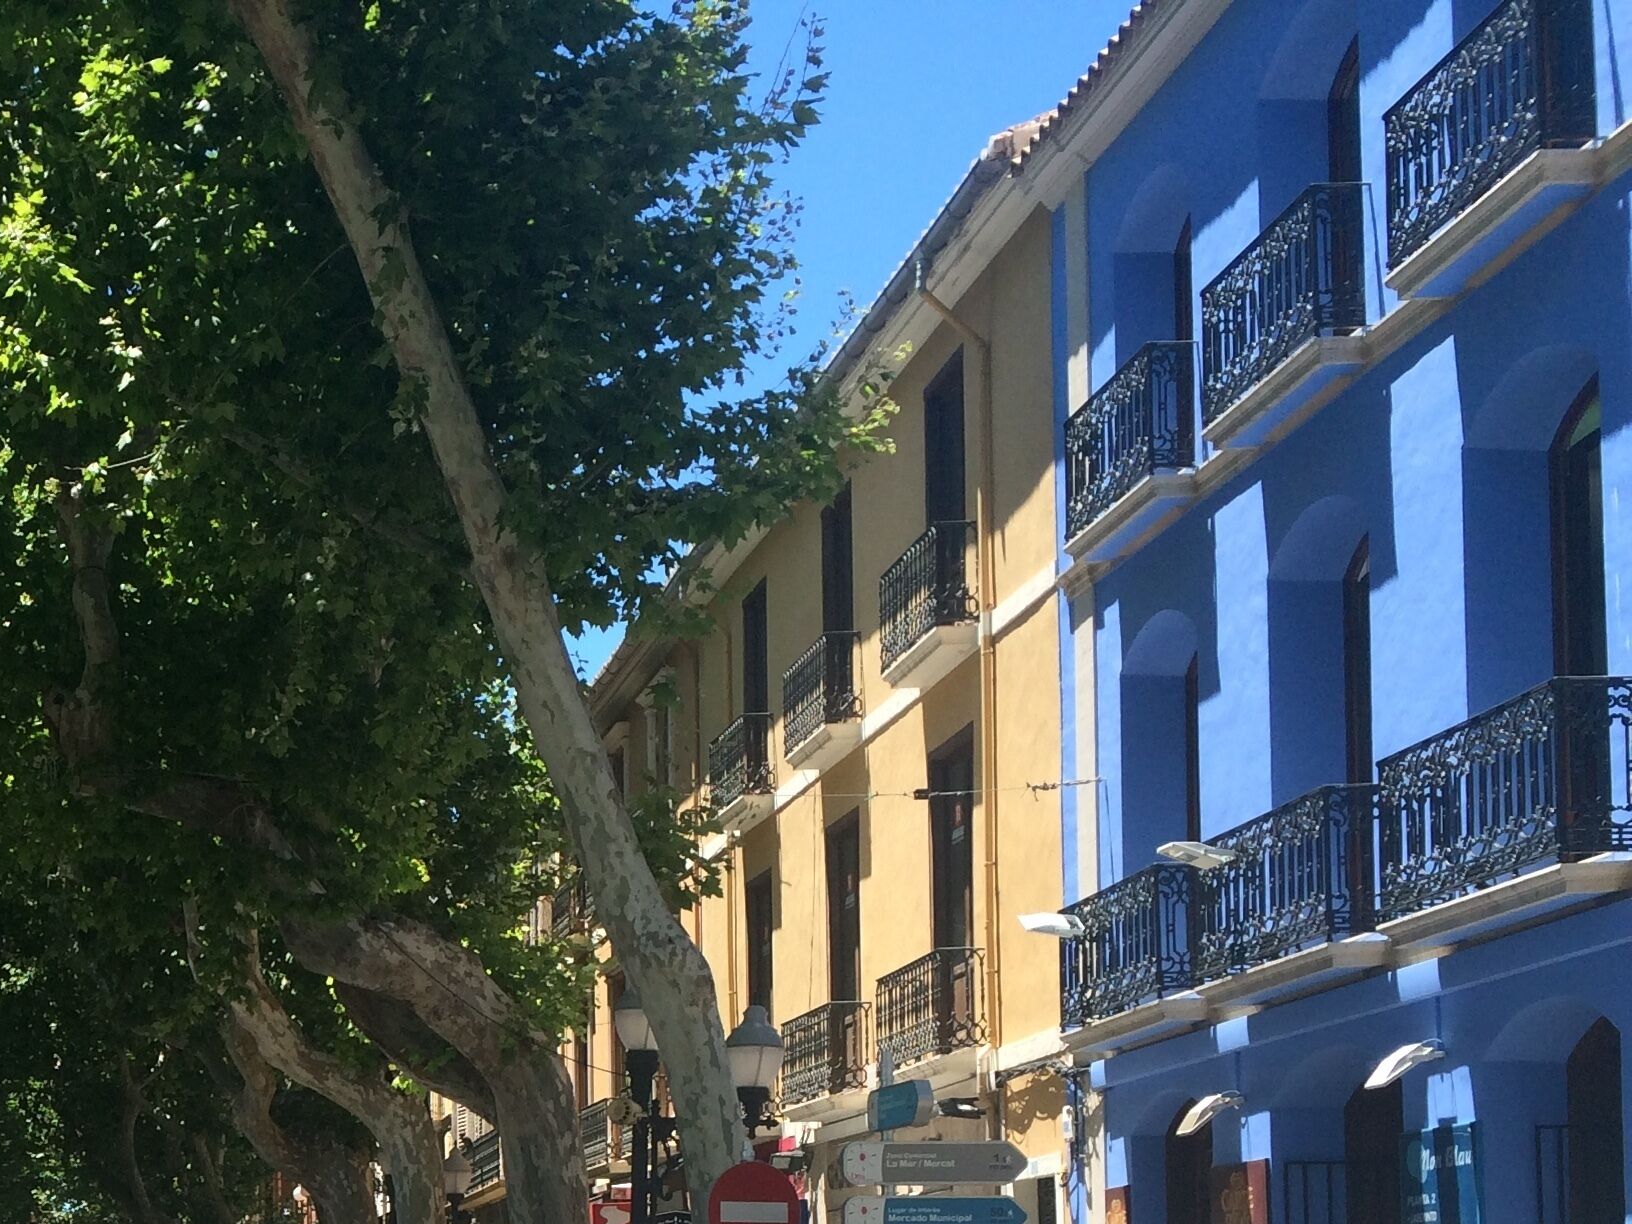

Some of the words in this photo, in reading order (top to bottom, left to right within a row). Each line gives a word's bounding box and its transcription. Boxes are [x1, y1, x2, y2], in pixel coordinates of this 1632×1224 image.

[886, 1159, 898, 1168] La
[888, 1214, 928, 1222] Mercado
[929, 1213, 973, 1223] Municipal
